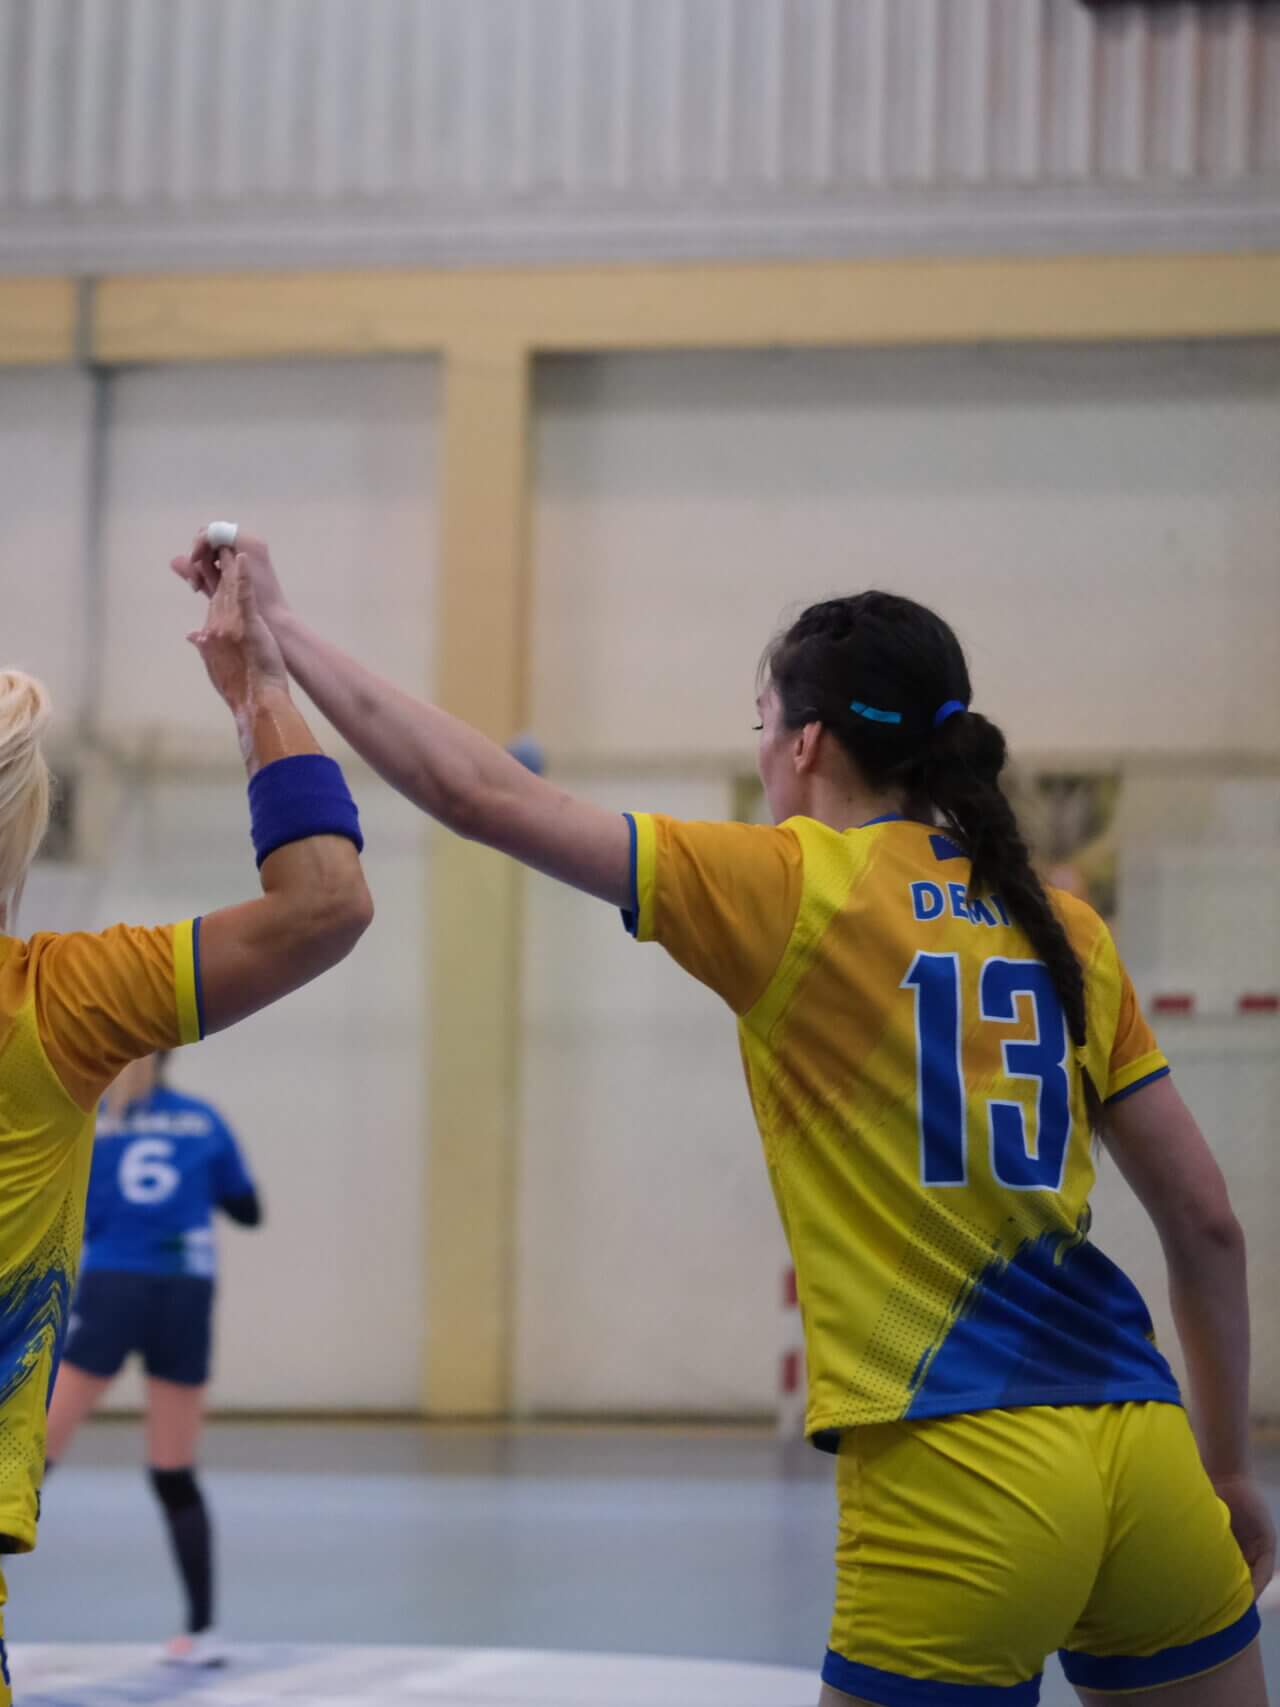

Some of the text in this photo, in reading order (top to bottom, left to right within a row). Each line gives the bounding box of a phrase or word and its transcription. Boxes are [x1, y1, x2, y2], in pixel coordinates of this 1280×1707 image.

[908, 880, 1012, 928] DEMI
[899, 950, 1071, 1193] 13
[117, 1137, 181, 1206] 6
